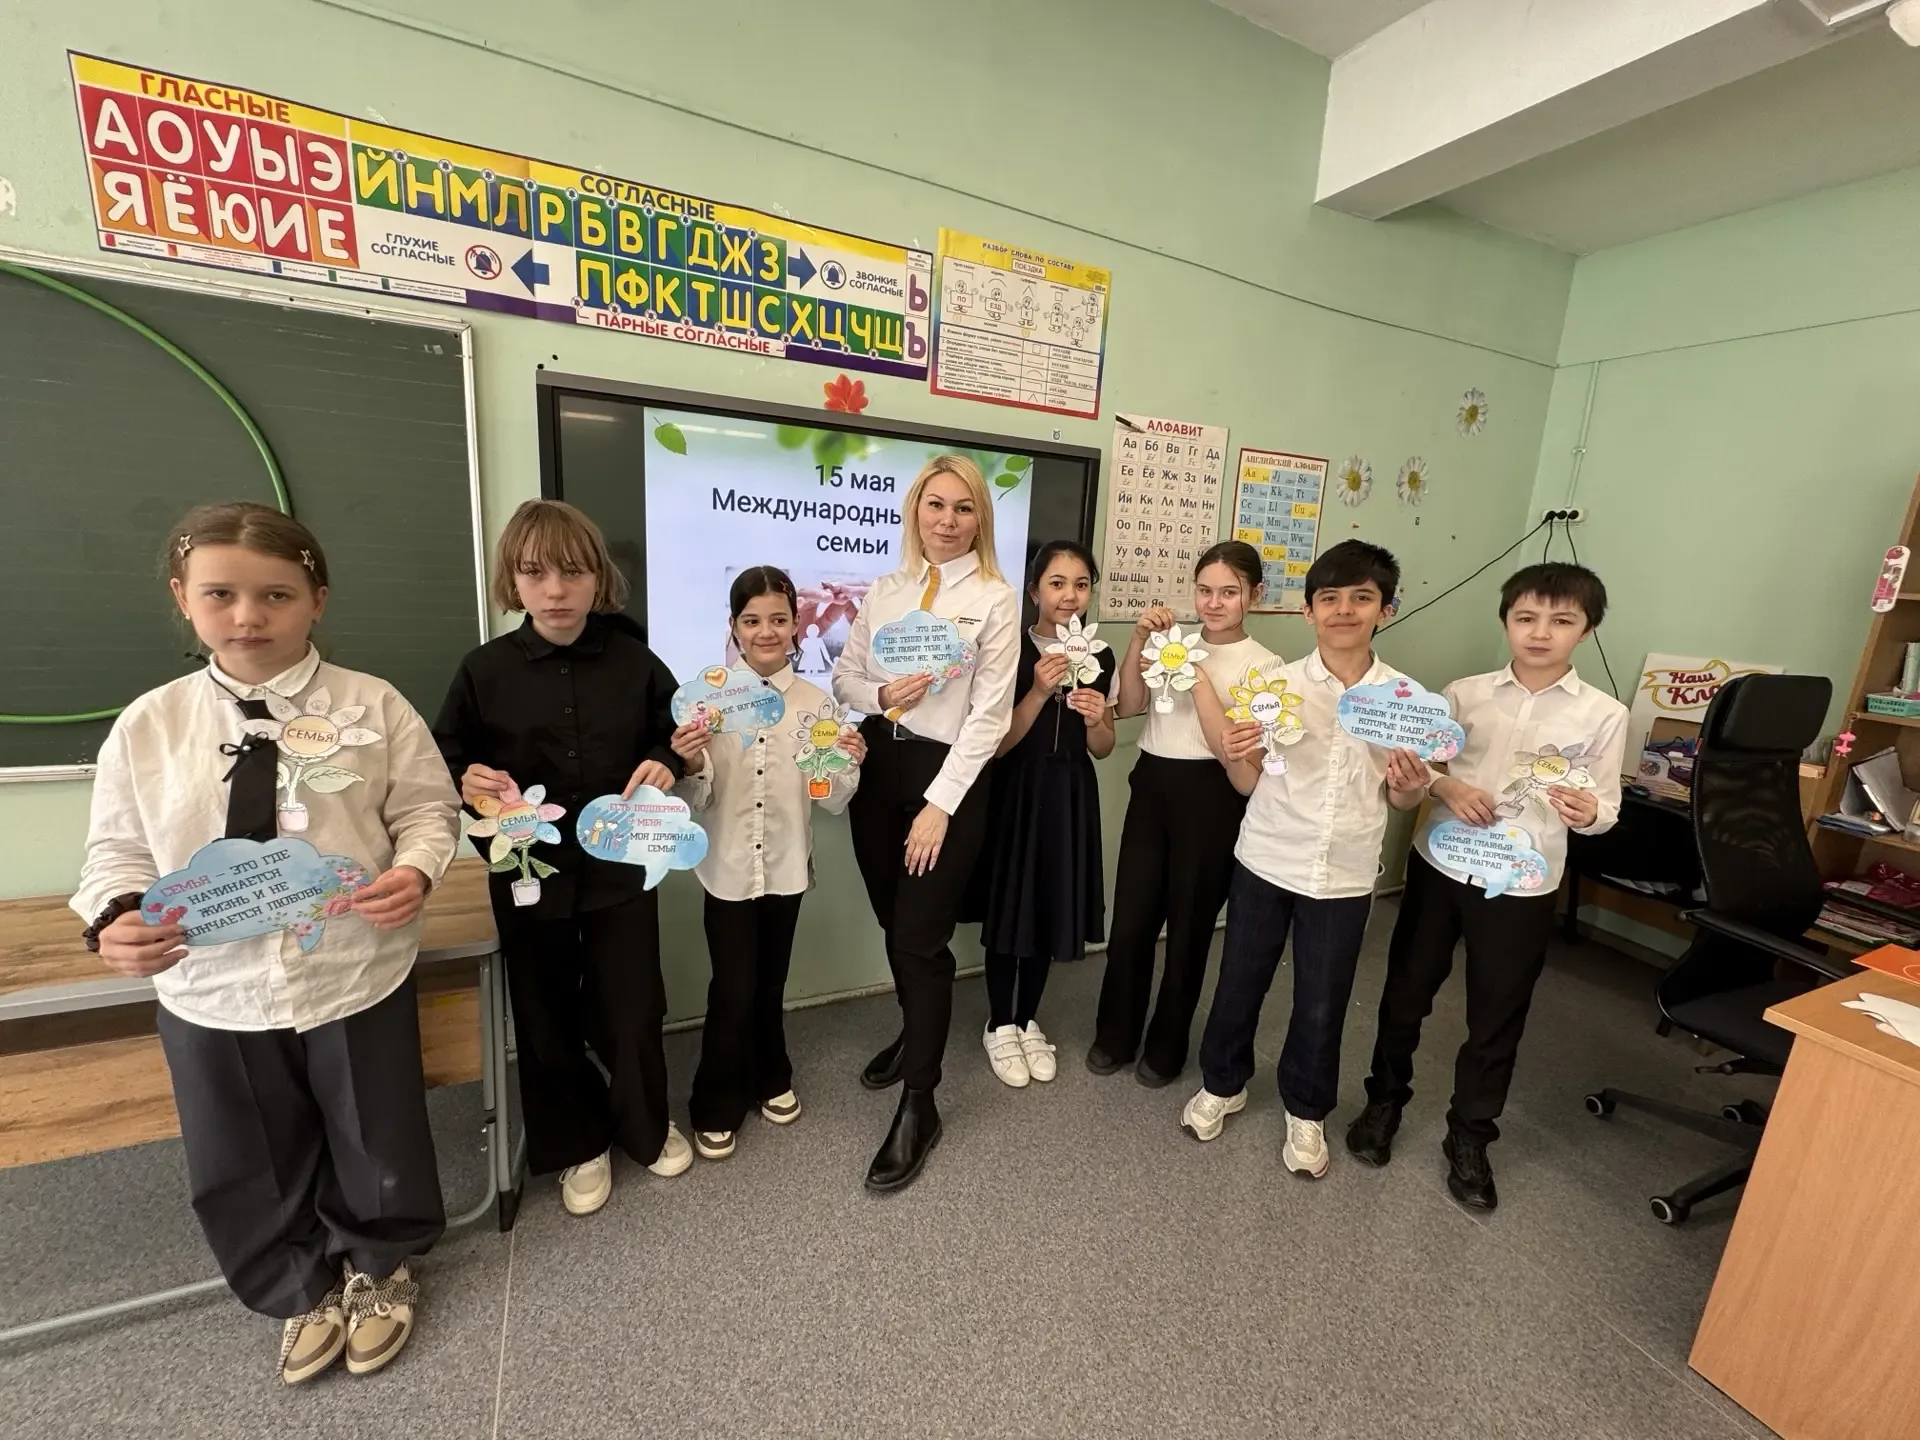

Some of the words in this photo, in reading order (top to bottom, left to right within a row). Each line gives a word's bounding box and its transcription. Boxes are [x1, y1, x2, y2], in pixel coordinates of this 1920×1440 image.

[140, 73, 290, 123] ГЛАСНЫЕ
[94, 98, 138, 155] А
[147, 110, 194, 164] О
[202, 119, 241, 172] У
[250, 127, 300, 186] Ы
[306, 142, 342, 191] Э
[580, 174, 715, 220] СОГЛАСНЫЕ
[103, 172, 148, 226] Я
[166, 173, 199, 236] Ё
[210, 189, 257, 243] Ю
[260, 197, 306, 253] И
[319, 208, 350, 260] Е
[356, 147, 398, 205] Й
[407, 169, 444, 213] Н
[451, 174, 488, 219] М
[494, 182, 528, 231] Л
[539, 191, 565, 236] Р
[579, 202, 606, 246] Б
[617, 211, 644, 255] В
[657, 218, 677, 260] Г
[688, 227, 719, 272] Д
[721, 232, 753, 276] Ж
[759, 242, 780, 282] З
[386, 232, 440, 251] ГЛУХИЕ
[371, 242, 456, 267] СОГЛАСНЫЕ
[982, 242, 1008, 253] РАЗБОР
[1011, 249, 1032, 261] СЛОВА
[1036, 256, 1045, 264] ПО
[1047, 257, 1075, 271] СОСТАВУ
[1014, 261, 1044, 275] ПОЕЗДКА
[855, 270, 898, 287] ЗВОНКИЕ
[849, 279, 904, 298] СОГЛАСНЫЕ
[579, 259, 611, 305] П
[616, 269, 649, 308] Ф
[656, 274, 681, 317] К
[691, 280, 717, 322] Т
[720, 287, 751, 331] Ш
[758, 296, 781, 333] С
[790, 300, 814, 342] Х
[819, 299, 847, 347] Ц
[851, 303, 871, 350] Ч
[874, 309, 903, 355] Щ
[956, 295, 967, 303] ПО
[989, 303, 1002, 311] ЕЗД
[596, 312, 668, 337] ПАРНЫЕ
[673, 326, 770, 355] СОГЛАСНЫЕ
[1147, 420, 1204, 437] АЛФАВИТ
[1245, 455, 1292, 467] АНГЛИЙСКИЙ
[1293, 463, 1323, 472] АЛФАВИТ
[815, 464, 843, 487] 15
[851, 472, 895, 493] мая
[816, 534, 889, 555] семьи
[884, 655, 915, 663] КОНЕЧНО
[1162, 652, 1185, 660] СЕМЬЯ
[1668, 671, 1716, 684] Наш
[705, 691, 723, 701] МОЯ
[724, 685, 750, 697] СЕМЬЯ
[736, 696, 777, 712] БОГАТСТВО
[1252, 701, 1281, 714] СЕМЬЯ
[1347, 694, 1375, 705] СЕМЬЯ
[1387, 701, 1404, 710] ЭТО
[1406, 704, 1447, 717] РАДОСТЬ
[1352, 706, 1387, 717] УЛЫБОК
[1390, 712, 1397, 720] И
[813, 729, 838, 738] СЕМЬЯ
[1358, 717, 1397, 731] КОТОРЫЕ
[1400, 725, 1425, 735] НАДО
[287, 728, 334, 743] СЕМЬЯ
[1350, 726, 1383, 738] ЦЕНИТЬ
[1396, 736, 1428, 746] БЕРЕЧЬ
[1536, 758, 1565, 776] СЕМЬЯ
[610, 803, 631, 812] ЕСТЬ
[635, 804, 687, 813] ПОДДЕРЖКА
[501, 813, 538, 829] СЕМЬЯ
[638, 818, 662, 827] МЕНЯ
[630, 832, 650, 841] МОЯ
[652, 833, 695, 842] ДРУЖНАЯ
[1452, 826, 1479, 836] СЕМЬЯ
[1489, 832, 1506, 841] ВОТ
[647, 844, 677, 853] СЕМЬЯ
[1442, 834, 1471, 845] САМЫЙ
[1474, 840, 1513, 852] ГЛАВНЫЙ
[1447, 854, 1467, 863] ВСЕХ
[1470, 858, 1502, 870] НАГРАД
[1464, 847, 1480, 856] ОНА
[1482, 850, 1517, 862] ДОРОЖЕ
[160, 874, 211, 898] СЕМЬЯ
[229, 861, 259, 876] ЭТО
[261, 849, 291, 866] ГДЕ
[186, 868, 283, 906] НАЧИНАЕТСЯ
[198, 896, 251, 918] ЖИЗНЬ
[252, 889, 266, 900] И
[267, 881, 290, 896] НЕ
[267, 886, 324, 911] ЛЮБОВЬ
